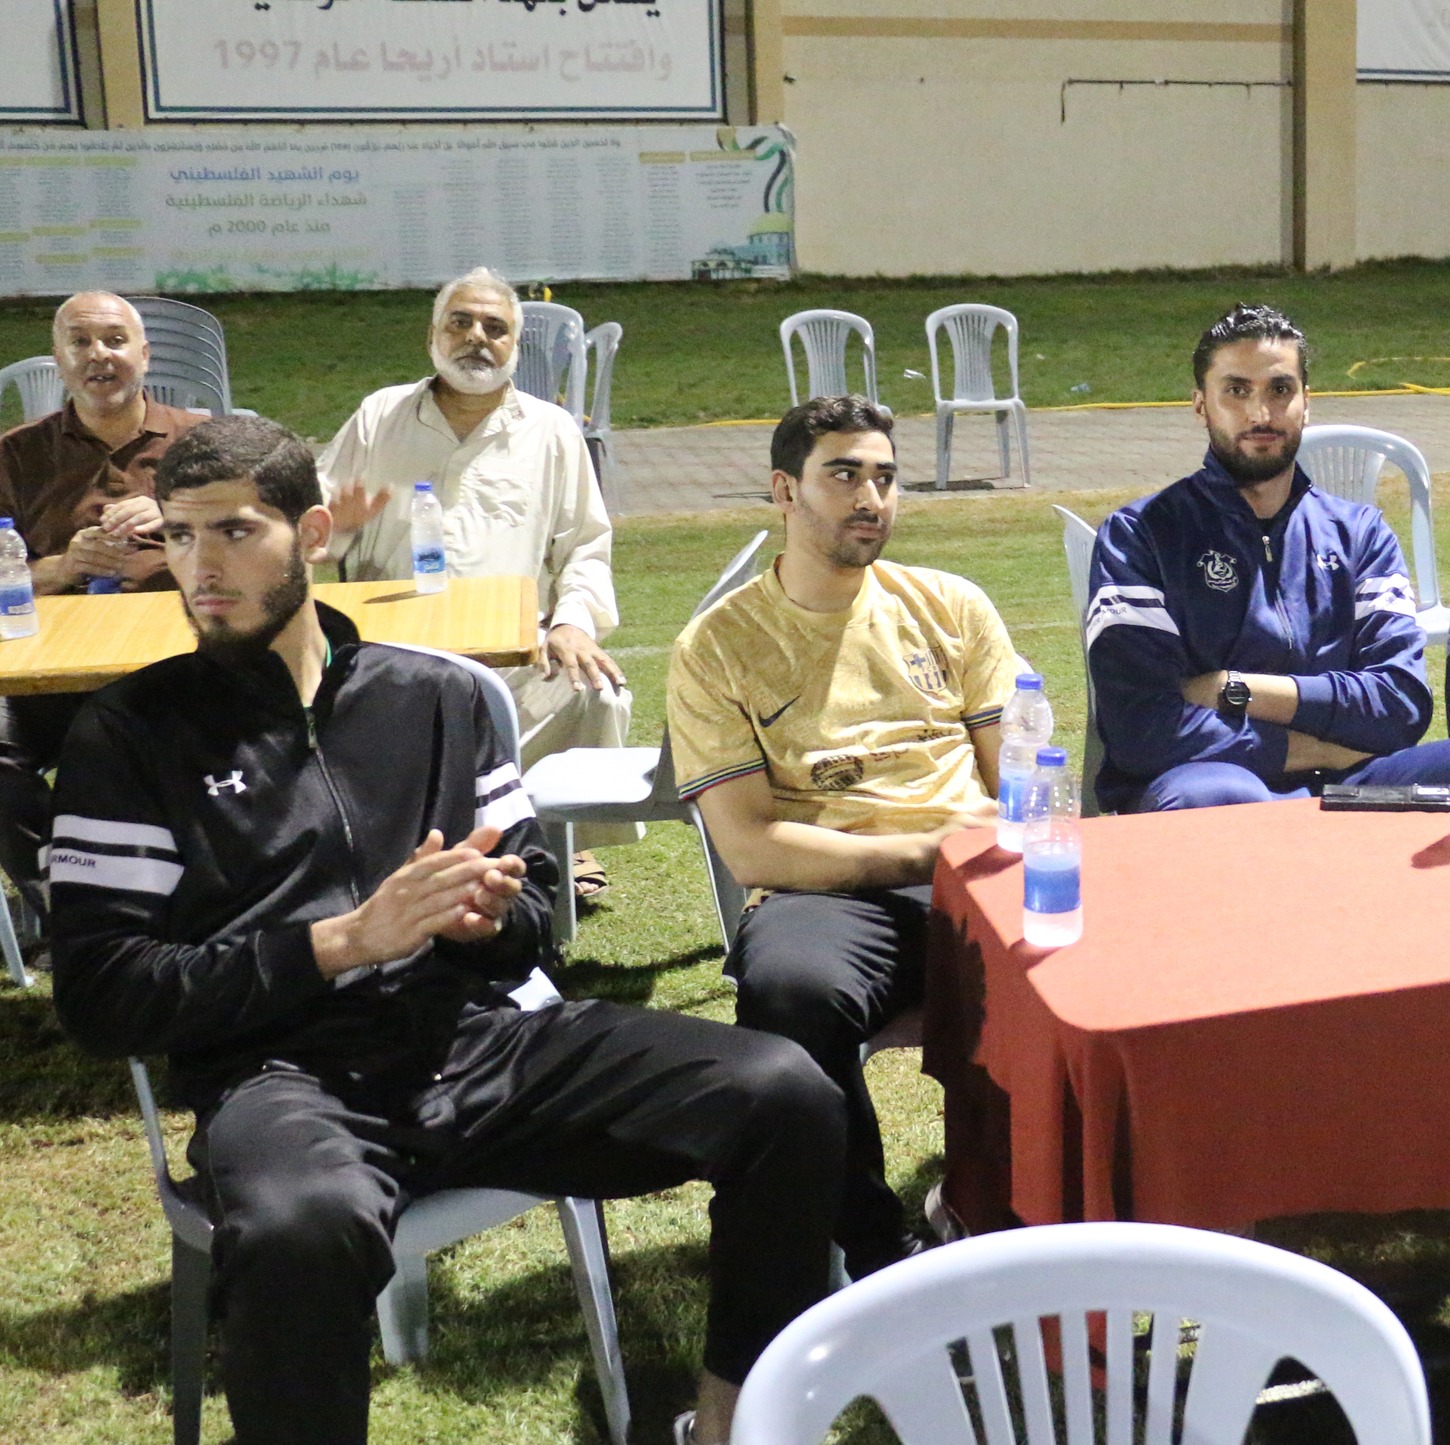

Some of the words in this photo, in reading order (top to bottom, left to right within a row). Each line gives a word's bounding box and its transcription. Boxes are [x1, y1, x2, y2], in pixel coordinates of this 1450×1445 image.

[213, 39, 302, 72] 1997
[314, 40, 370, 79] عام
[380, 37, 462, 82] أريحا
[558, 38, 673, 82] وافتتاح
[170, 166, 262, 184] الفلسطيني
[266, 166, 323, 183] الشهيد
[327, 168, 360, 184] يوم
[164, 193, 254, 210] الفلسطينية
[259, 192, 312, 210] الرياضة
[317, 192, 368, 207] شهداء
[208, 223, 222, 237] م
[226, 220, 266, 234] 2000
[271, 219, 300, 236] عام
[304, 219, 332, 234] منذ
